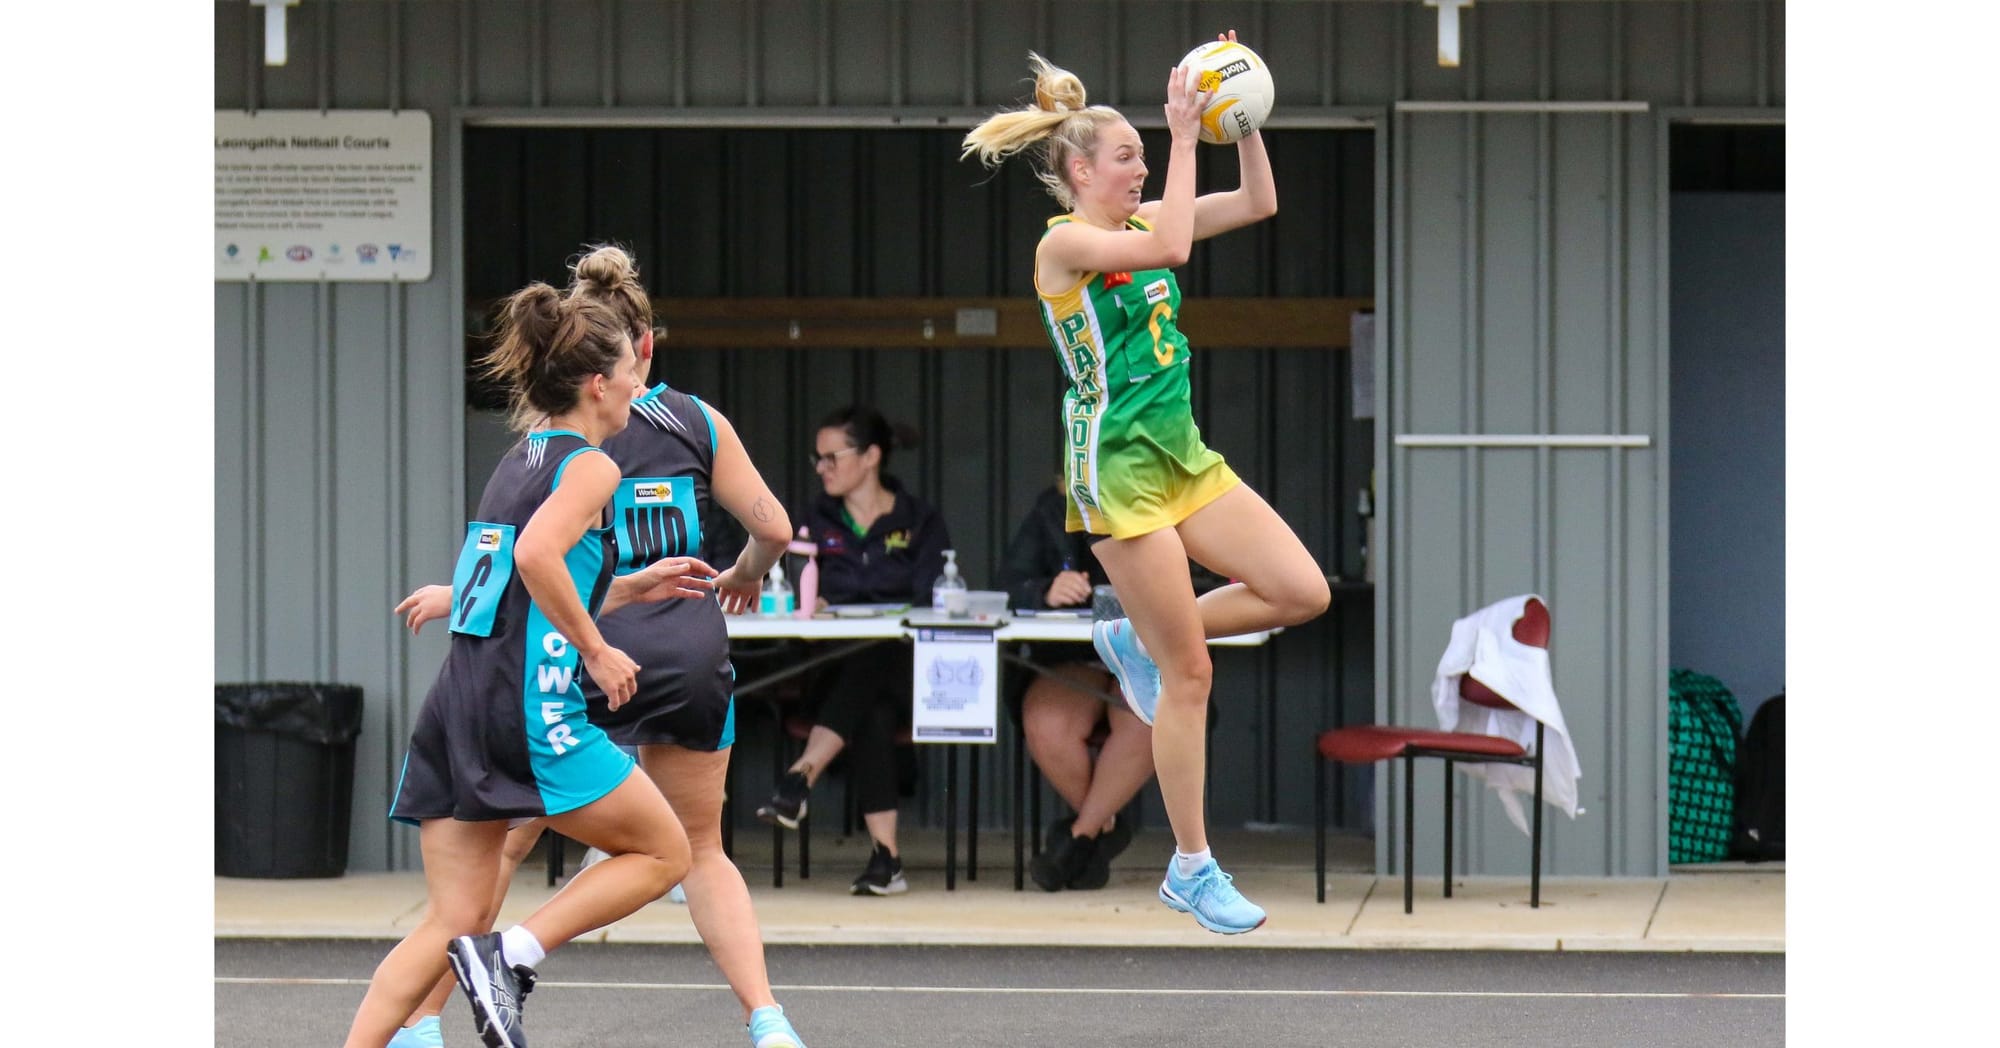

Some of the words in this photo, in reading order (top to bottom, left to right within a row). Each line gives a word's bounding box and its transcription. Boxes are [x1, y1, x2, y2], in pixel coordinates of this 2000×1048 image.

[215, 136, 286, 150] Leongatha
[290, 136, 338, 149] Netball
[343, 136, 390, 149] Courts
[625, 506, 688, 568] WD
[458, 553, 493, 627] C
[538, 632, 581, 756] OWER
